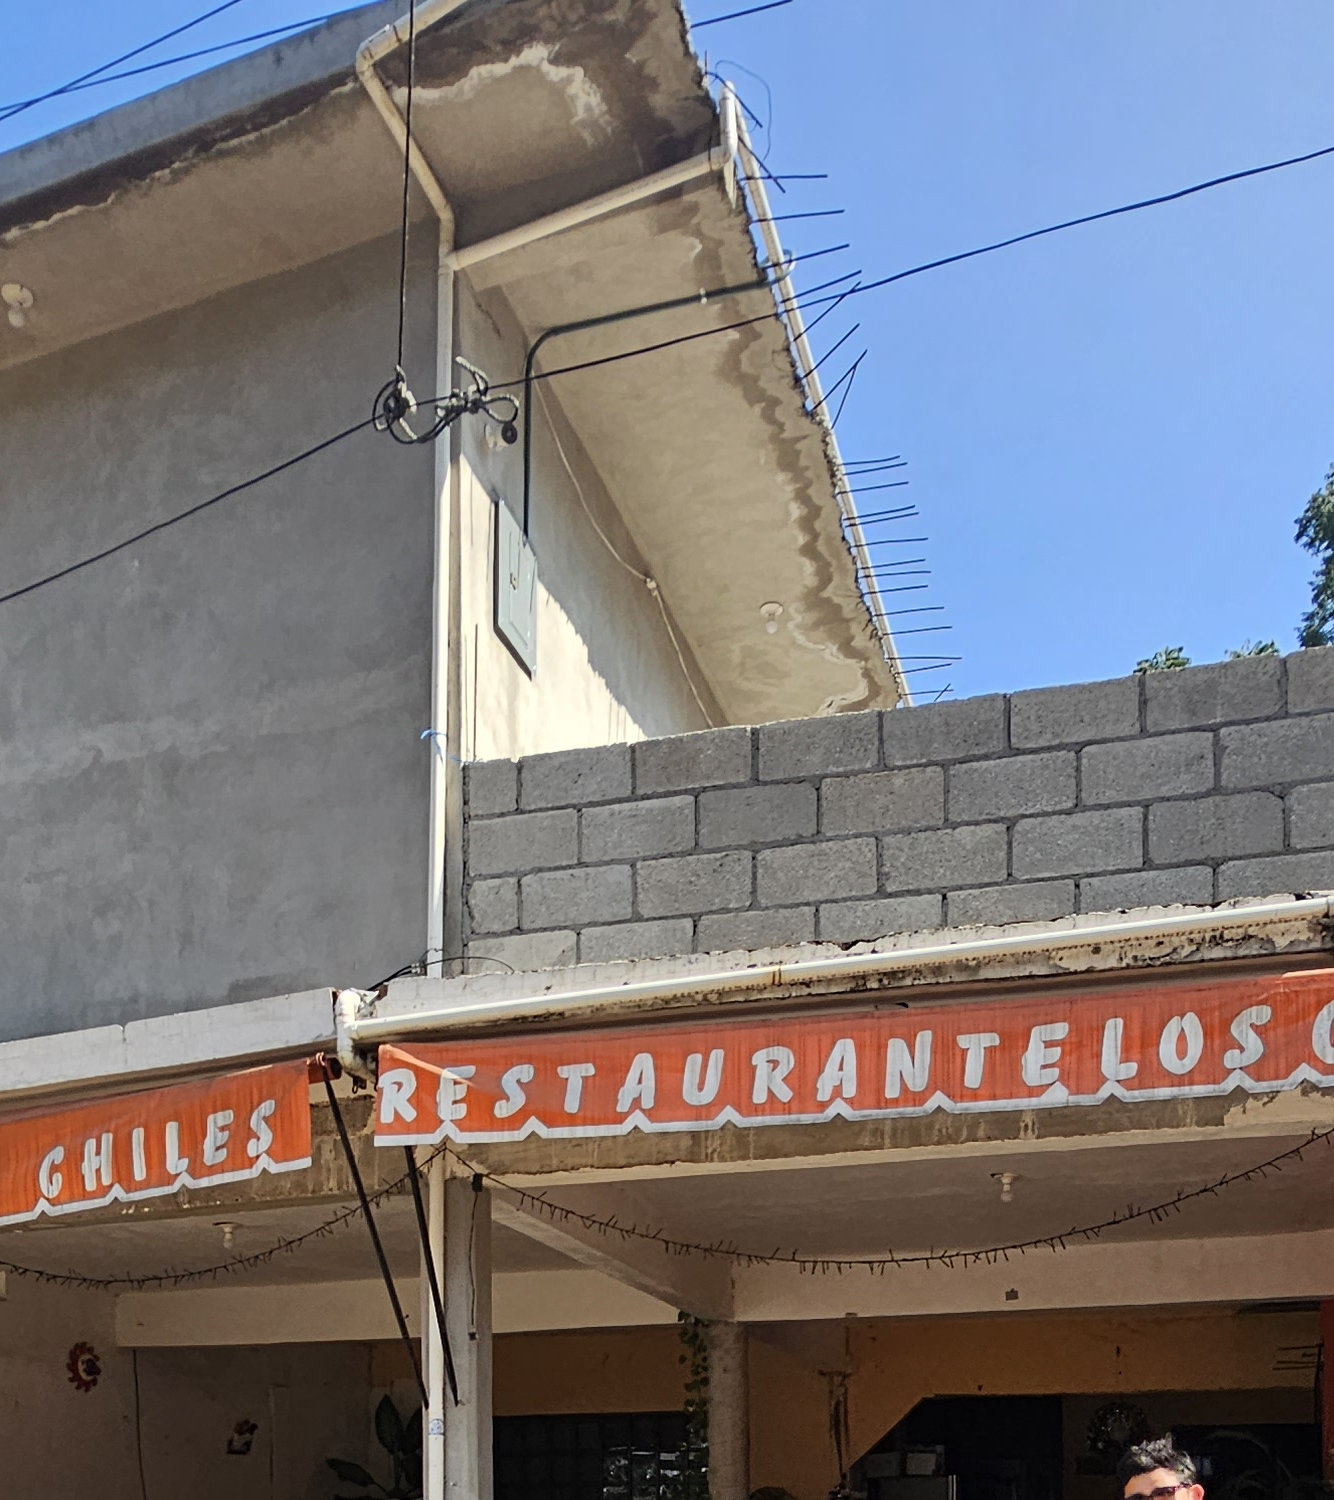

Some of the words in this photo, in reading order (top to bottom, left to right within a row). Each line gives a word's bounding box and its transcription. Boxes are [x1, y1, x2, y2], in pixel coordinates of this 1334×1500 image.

[378, 1022, 1069, 1124] RESTAURANTE
[1101, 1004, 1271, 1081] LOS
[39, 1100, 276, 1199] CHILES
